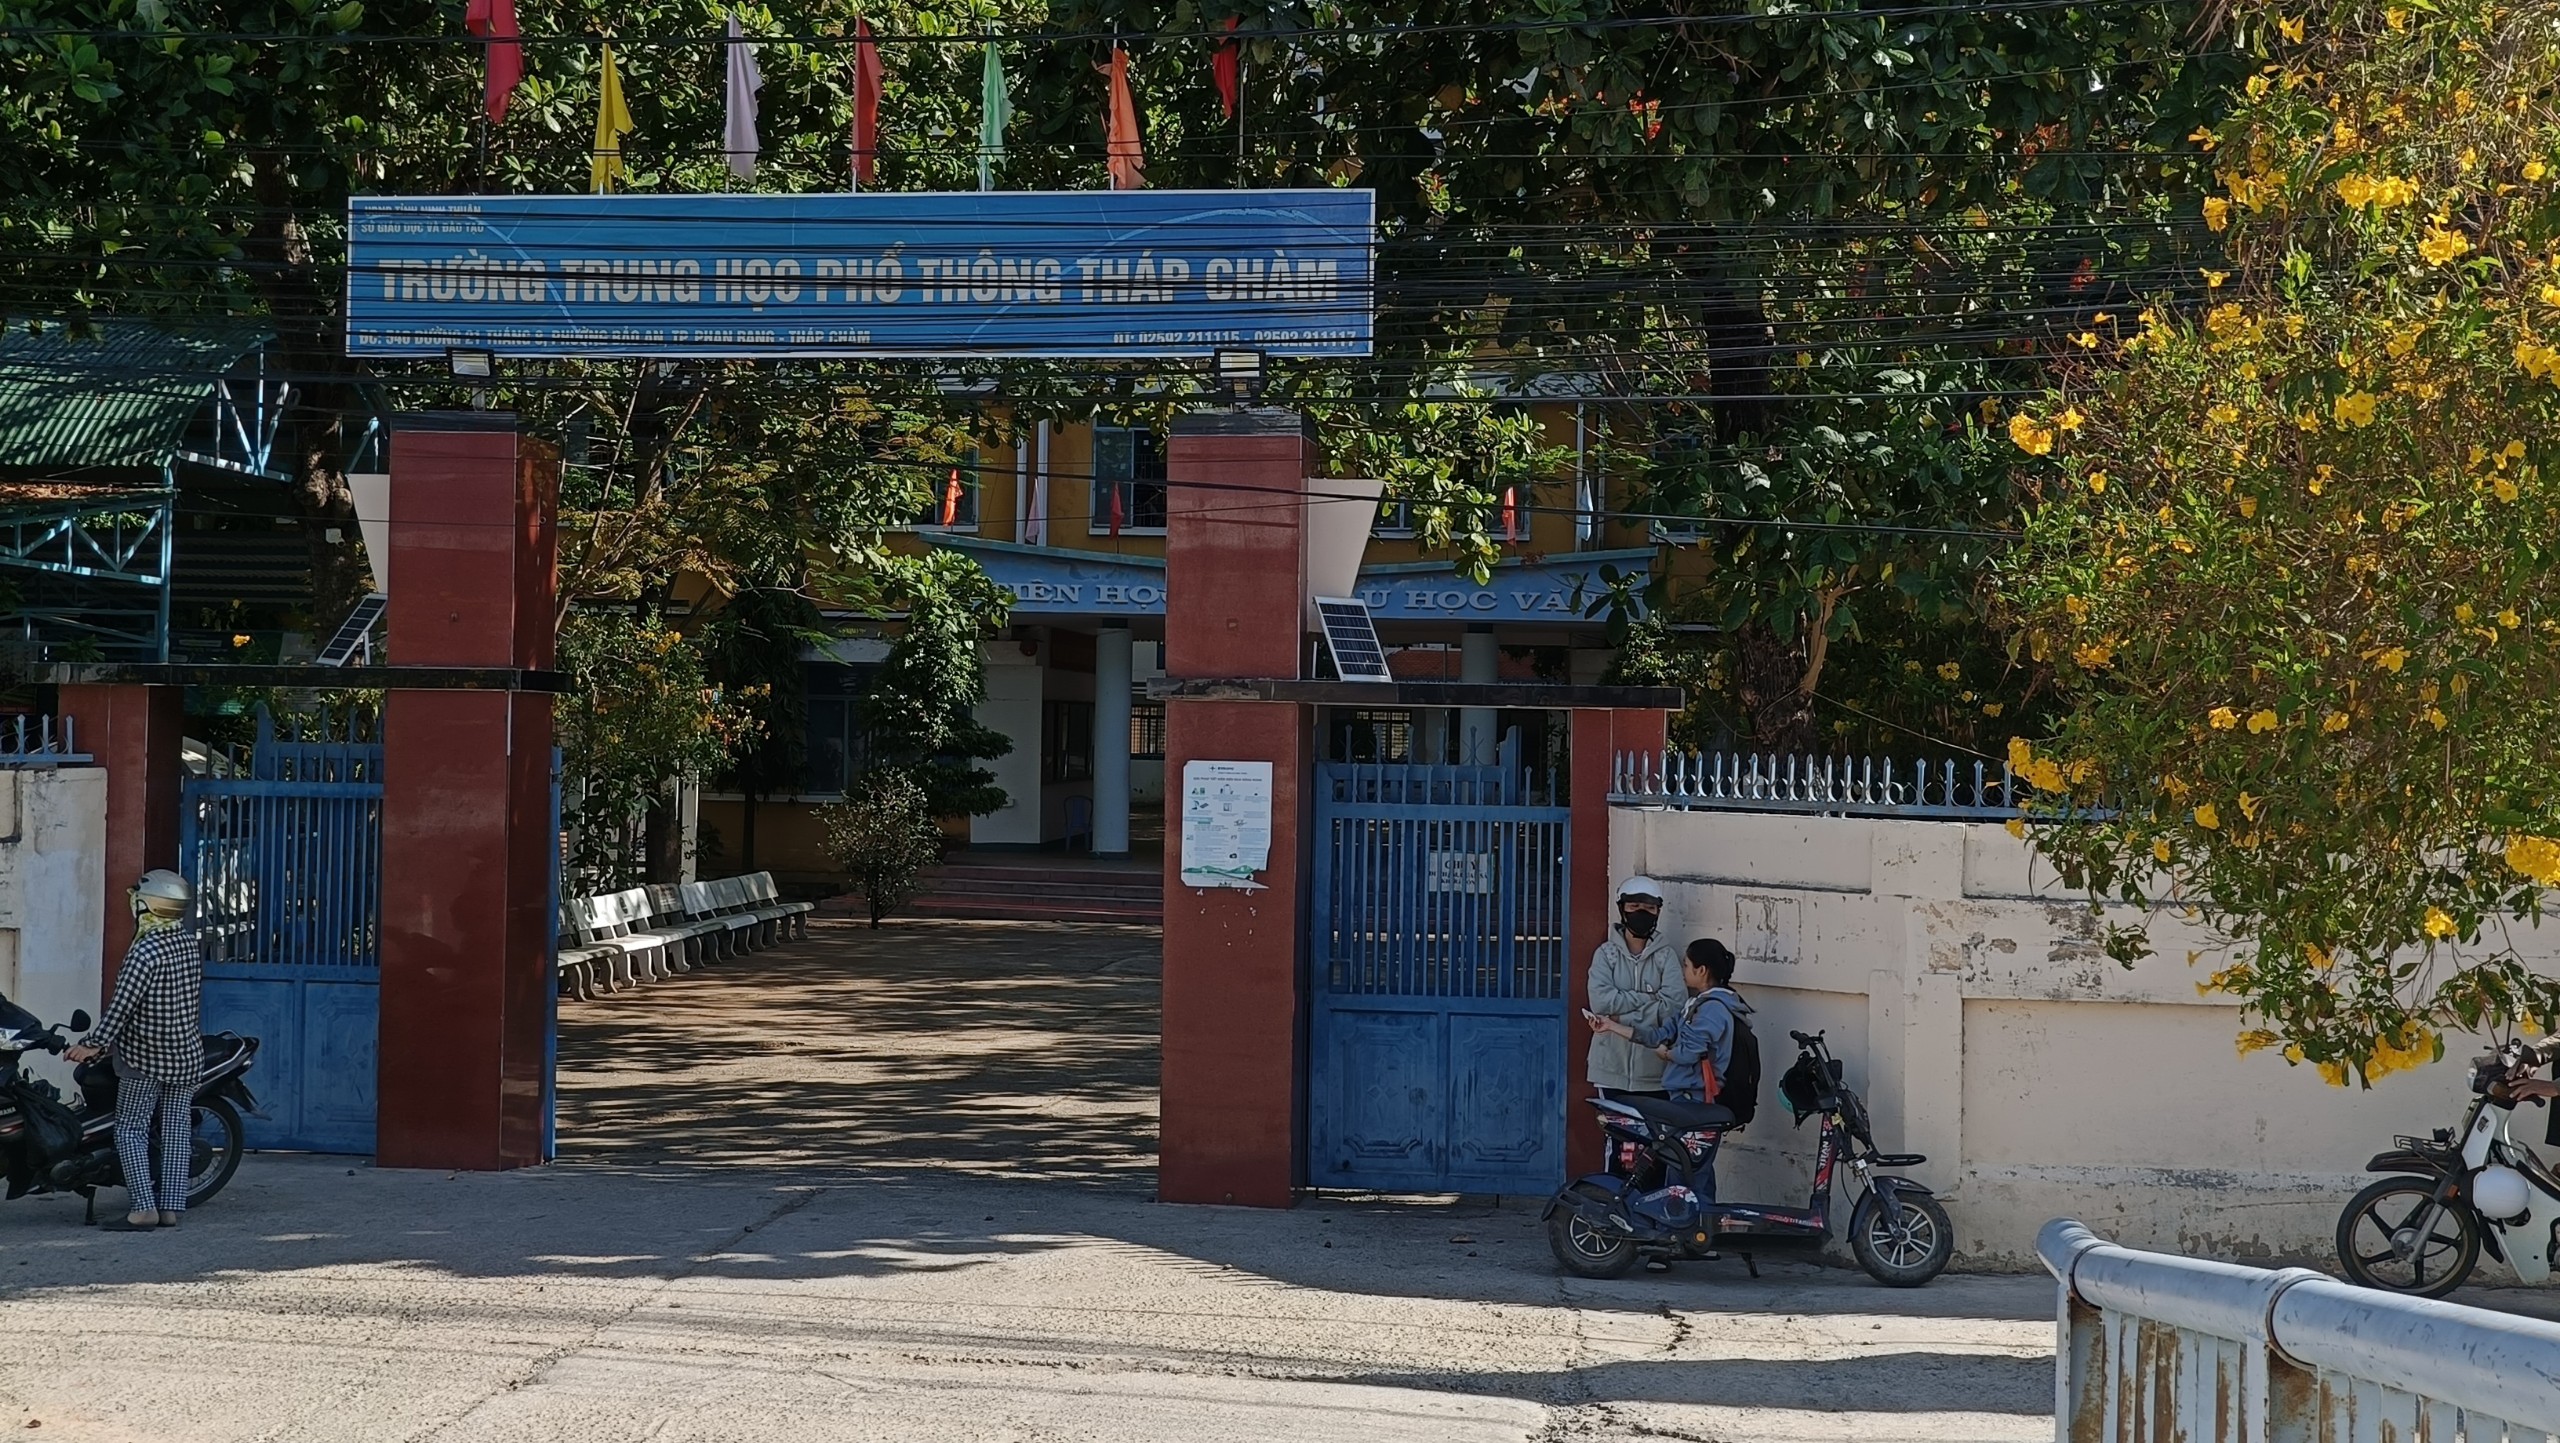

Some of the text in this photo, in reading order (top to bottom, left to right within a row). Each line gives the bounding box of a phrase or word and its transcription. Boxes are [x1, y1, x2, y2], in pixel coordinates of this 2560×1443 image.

[378, 240, 1338, 312] TRƯỜNG TRUNG HỌC PHỔ THÔNG THÁP CHÀM
[485, 326, 531, 346] THÁNG
[694, 329, 733, 345] PHAN
[737, 329, 776, 345] RANG
[788, 327, 825, 345] THÁP
[828, 327, 872, 345] CHÀM
[1095, 584, 1166, 609] HỌ
[1404, 590, 1498, 615] HỌC
